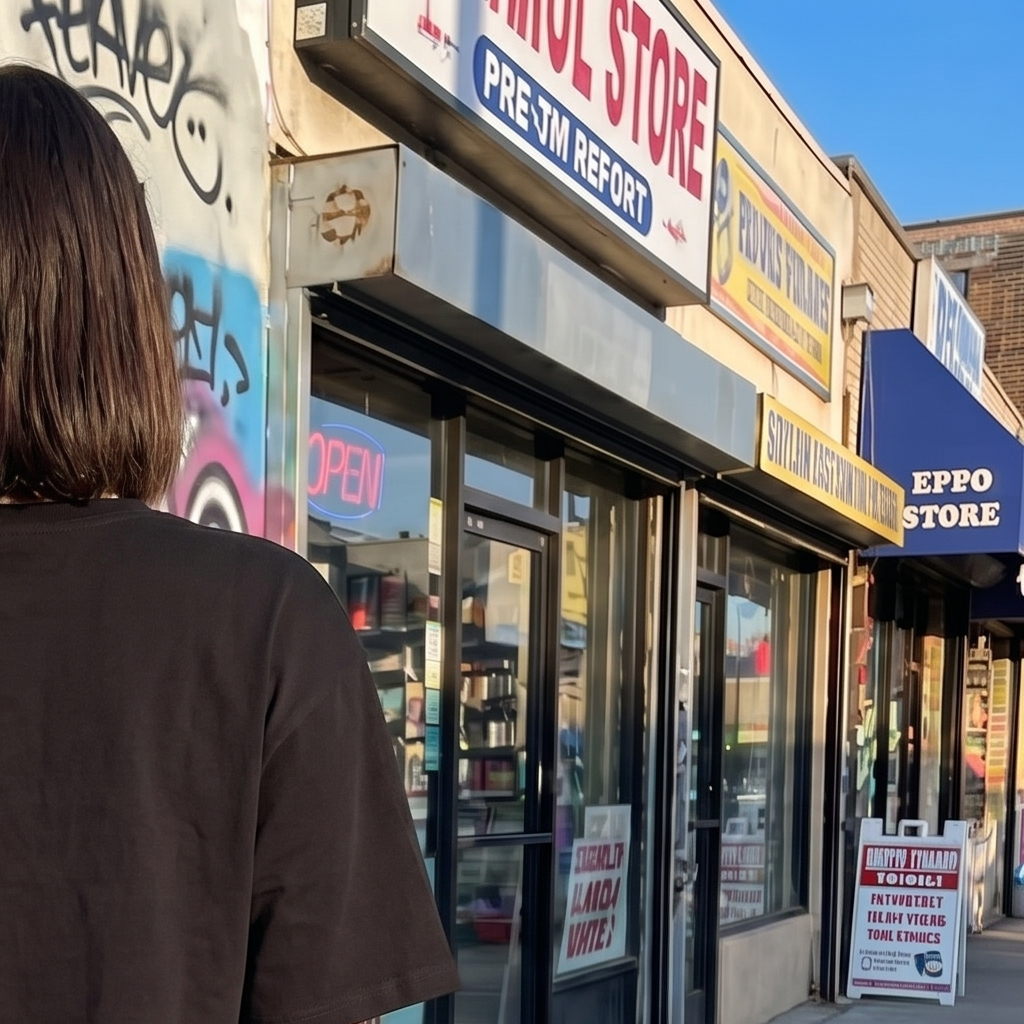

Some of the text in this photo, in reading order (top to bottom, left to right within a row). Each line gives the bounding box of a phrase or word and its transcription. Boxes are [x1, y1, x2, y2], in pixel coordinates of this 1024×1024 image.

[605, 0, 708, 201] STORE
[573, 127, 648, 225] REFORT
[307, 432, 383, 510] OPEN
[911, 468, 993, 495] EPPO
[902, 501, 1000, 530] STORE
